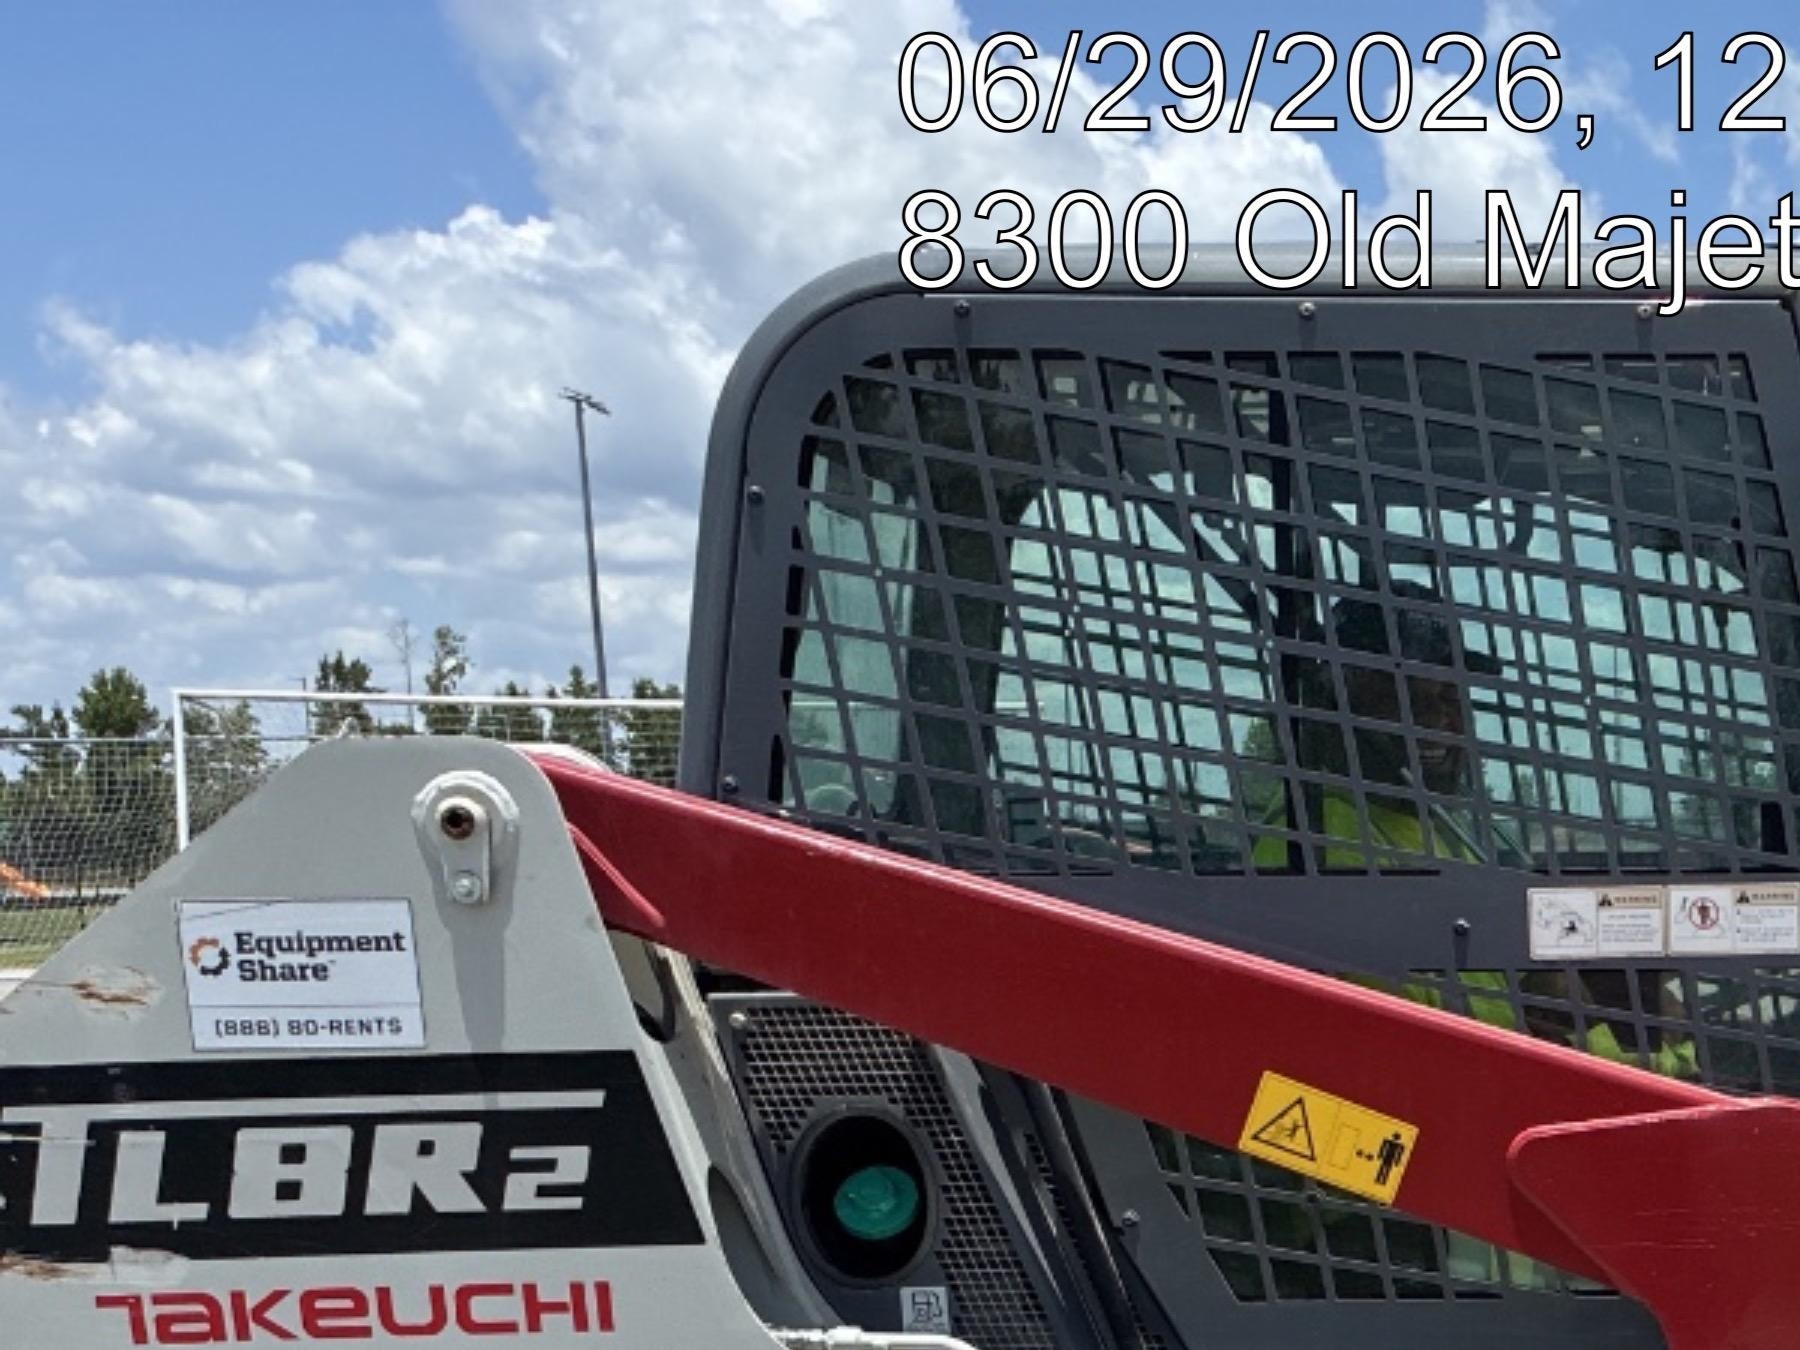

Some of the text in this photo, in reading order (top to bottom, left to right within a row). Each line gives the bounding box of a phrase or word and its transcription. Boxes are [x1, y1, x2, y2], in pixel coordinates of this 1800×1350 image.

[233, 929, 407, 958] Equipment
[215, 1016, 403, 1038] (888) 80-RENTS
[95, 1280, 616, 1345] TAKEUCHI
